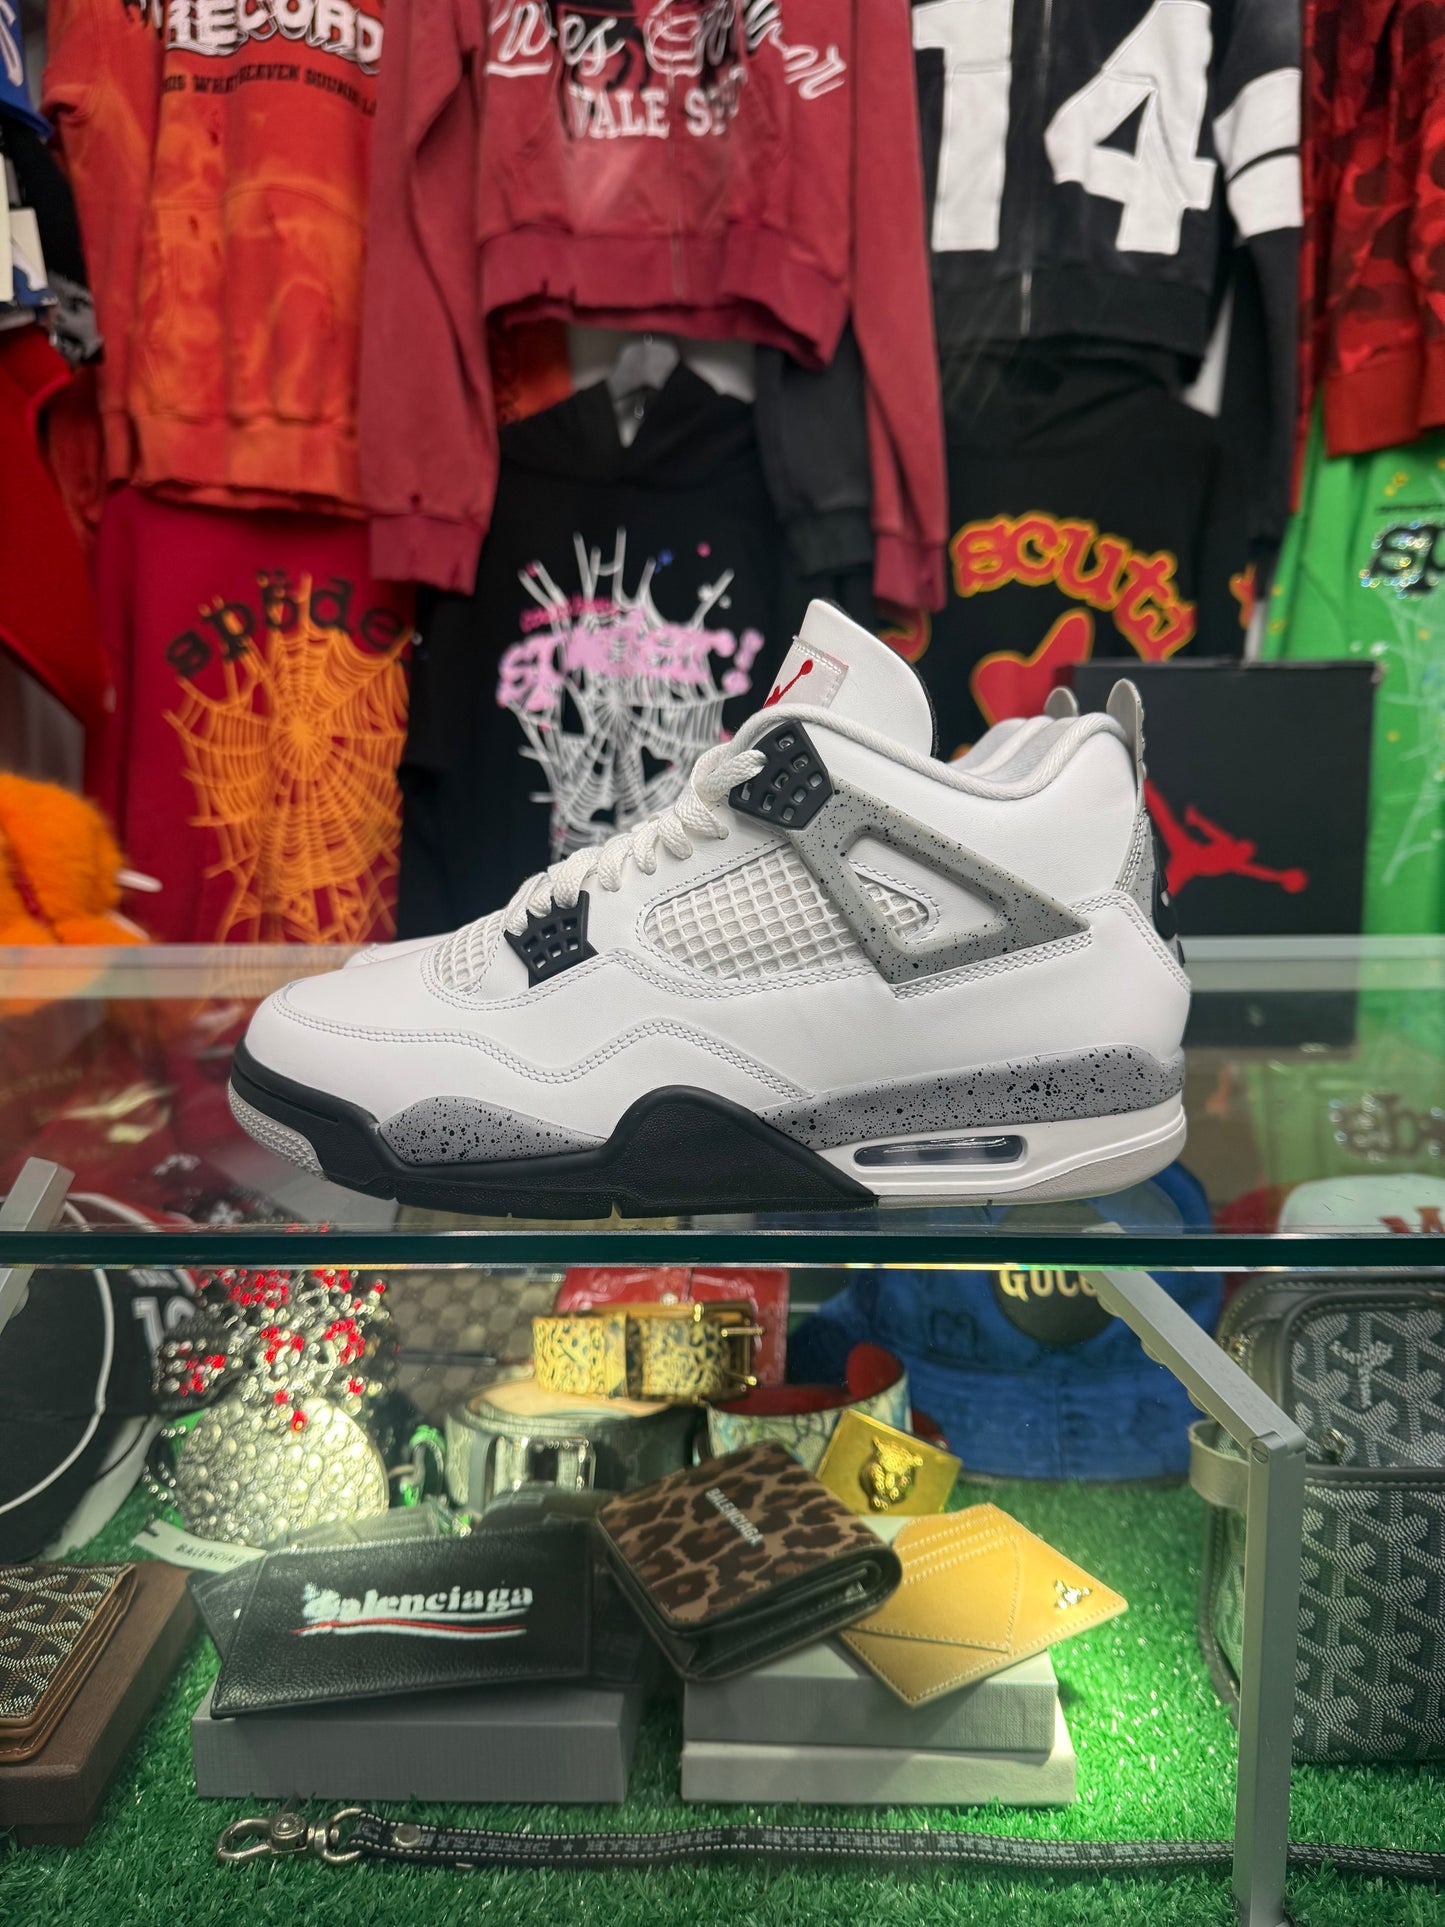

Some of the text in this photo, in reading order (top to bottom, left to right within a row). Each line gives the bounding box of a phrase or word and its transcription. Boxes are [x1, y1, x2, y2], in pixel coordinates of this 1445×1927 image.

[912, 0, 1217, 254] 14
[704, 1487, 764, 1547] BALENCIAGA
[761, 1832, 901, 1848] HYSTERIC
